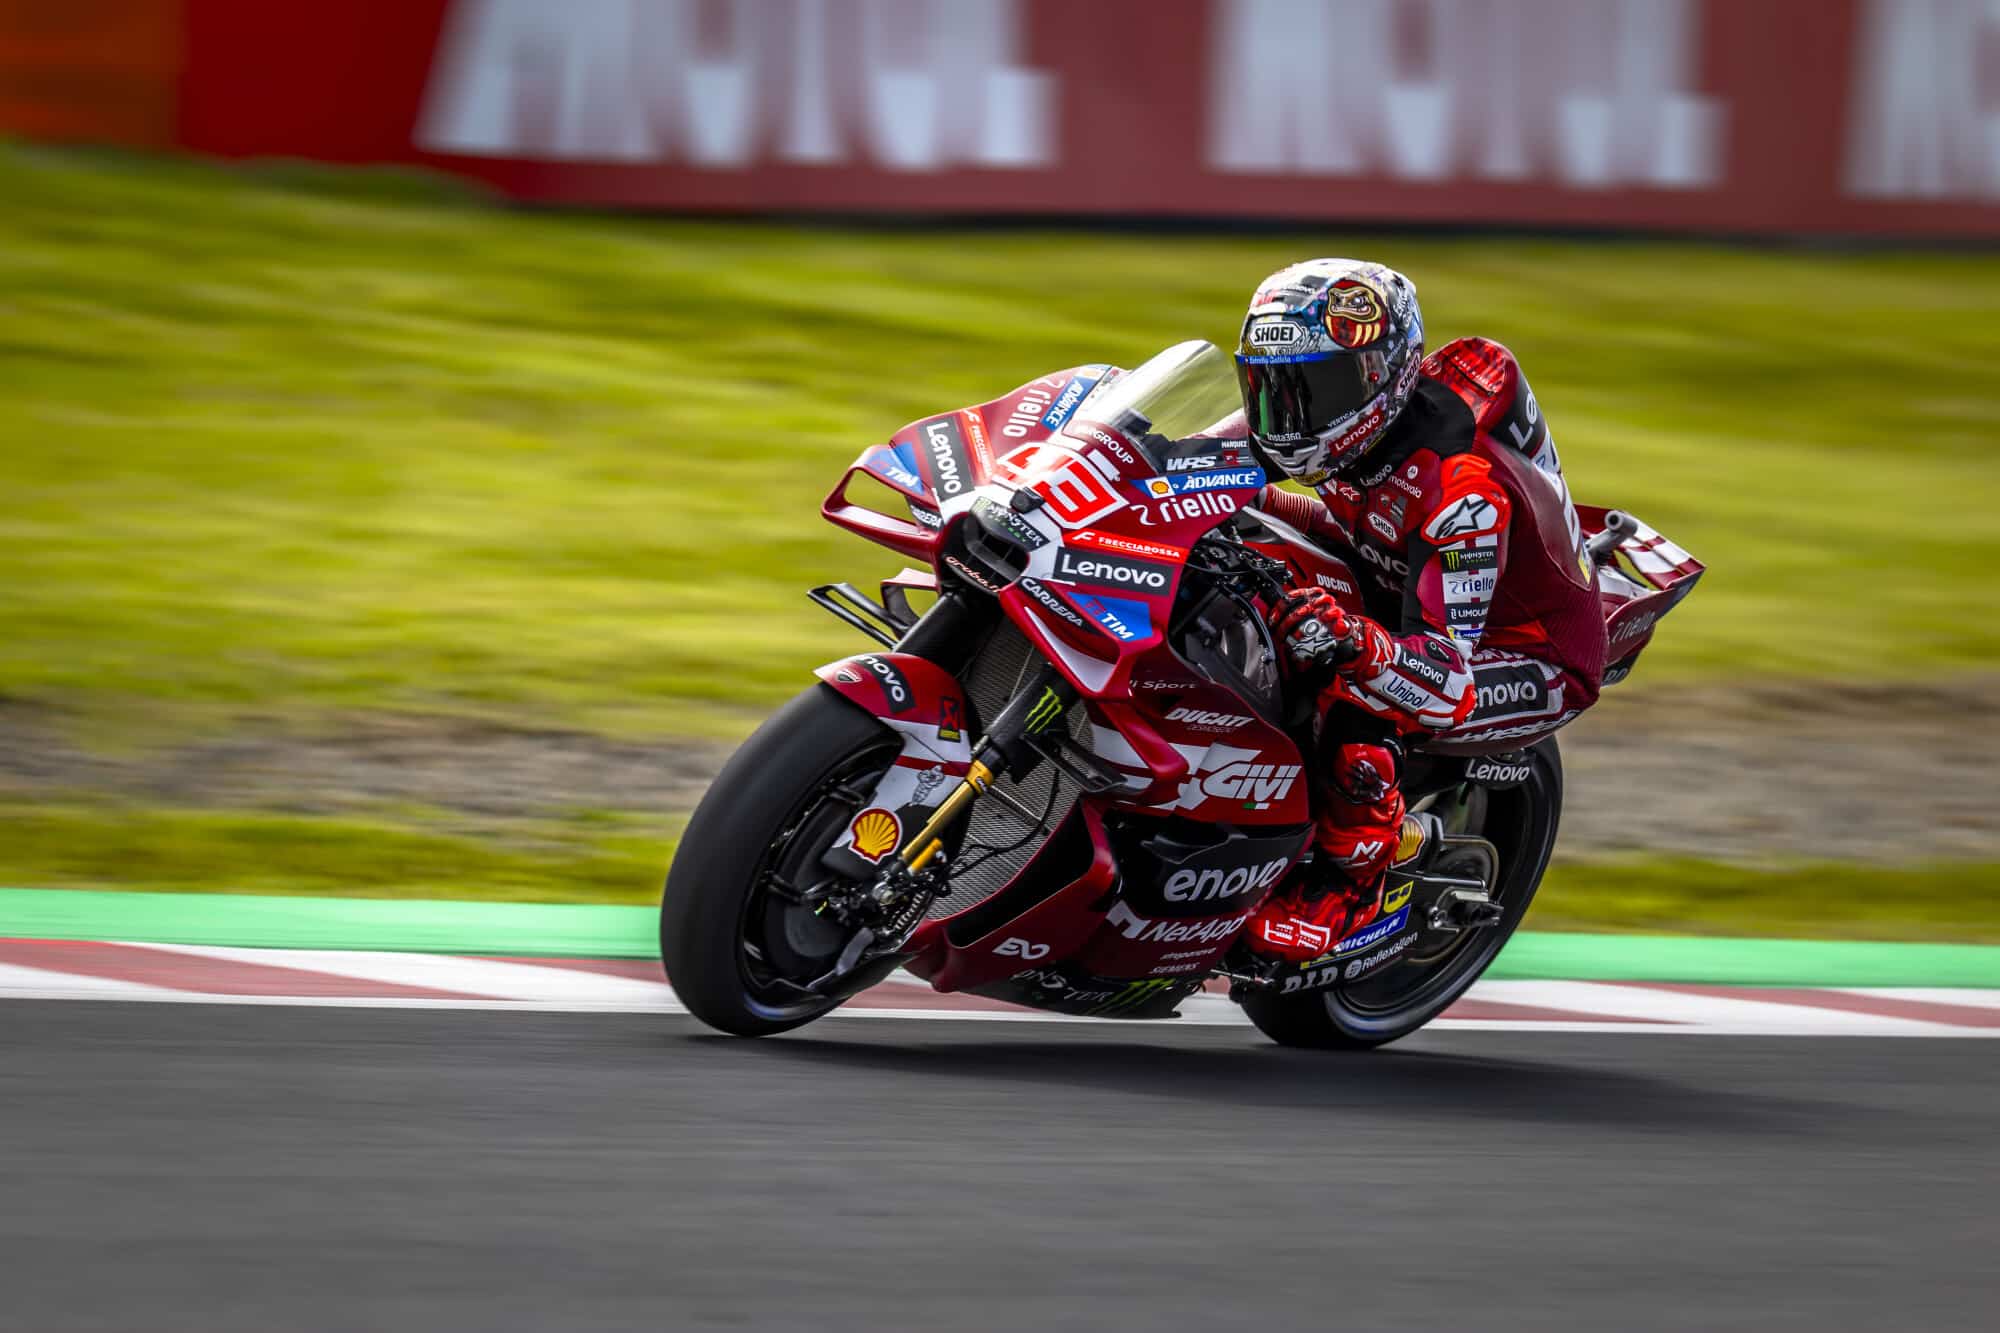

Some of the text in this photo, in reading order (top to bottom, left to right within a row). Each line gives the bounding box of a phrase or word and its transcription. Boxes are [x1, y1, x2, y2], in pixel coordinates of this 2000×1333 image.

[1254, 326, 1294, 342] SHOEI
[1003, 388, 1051, 437] riello
[1335, 415, 1380, 451] Lenovo
[926, 421, 962, 494] Lenovo
[1166, 455, 1217, 471] WRS
[1159, 492, 1237, 523] riello
[1098, 537, 1180, 558] FRECCIAROSSA
[1061, 553, 1166, 587] Lenovo
[1316, 573, 1352, 595] DUCATI
[1462, 577, 1493, 592] riello
[1021, 577, 1084, 628] CARRERA
[1100, 613, 1135, 640] TIM
[1403, 652, 1444, 684] Lenovo
[1142, 680, 1198, 690] Sport
[1386, 676, 1430, 708] Unipol
[1164, 707, 1256, 727] DUCATI
[1203, 764, 1303, 801] GIVI
[1465, 758, 1530, 782] Lenovo
[1139, 915, 1247, 943] NetApp
